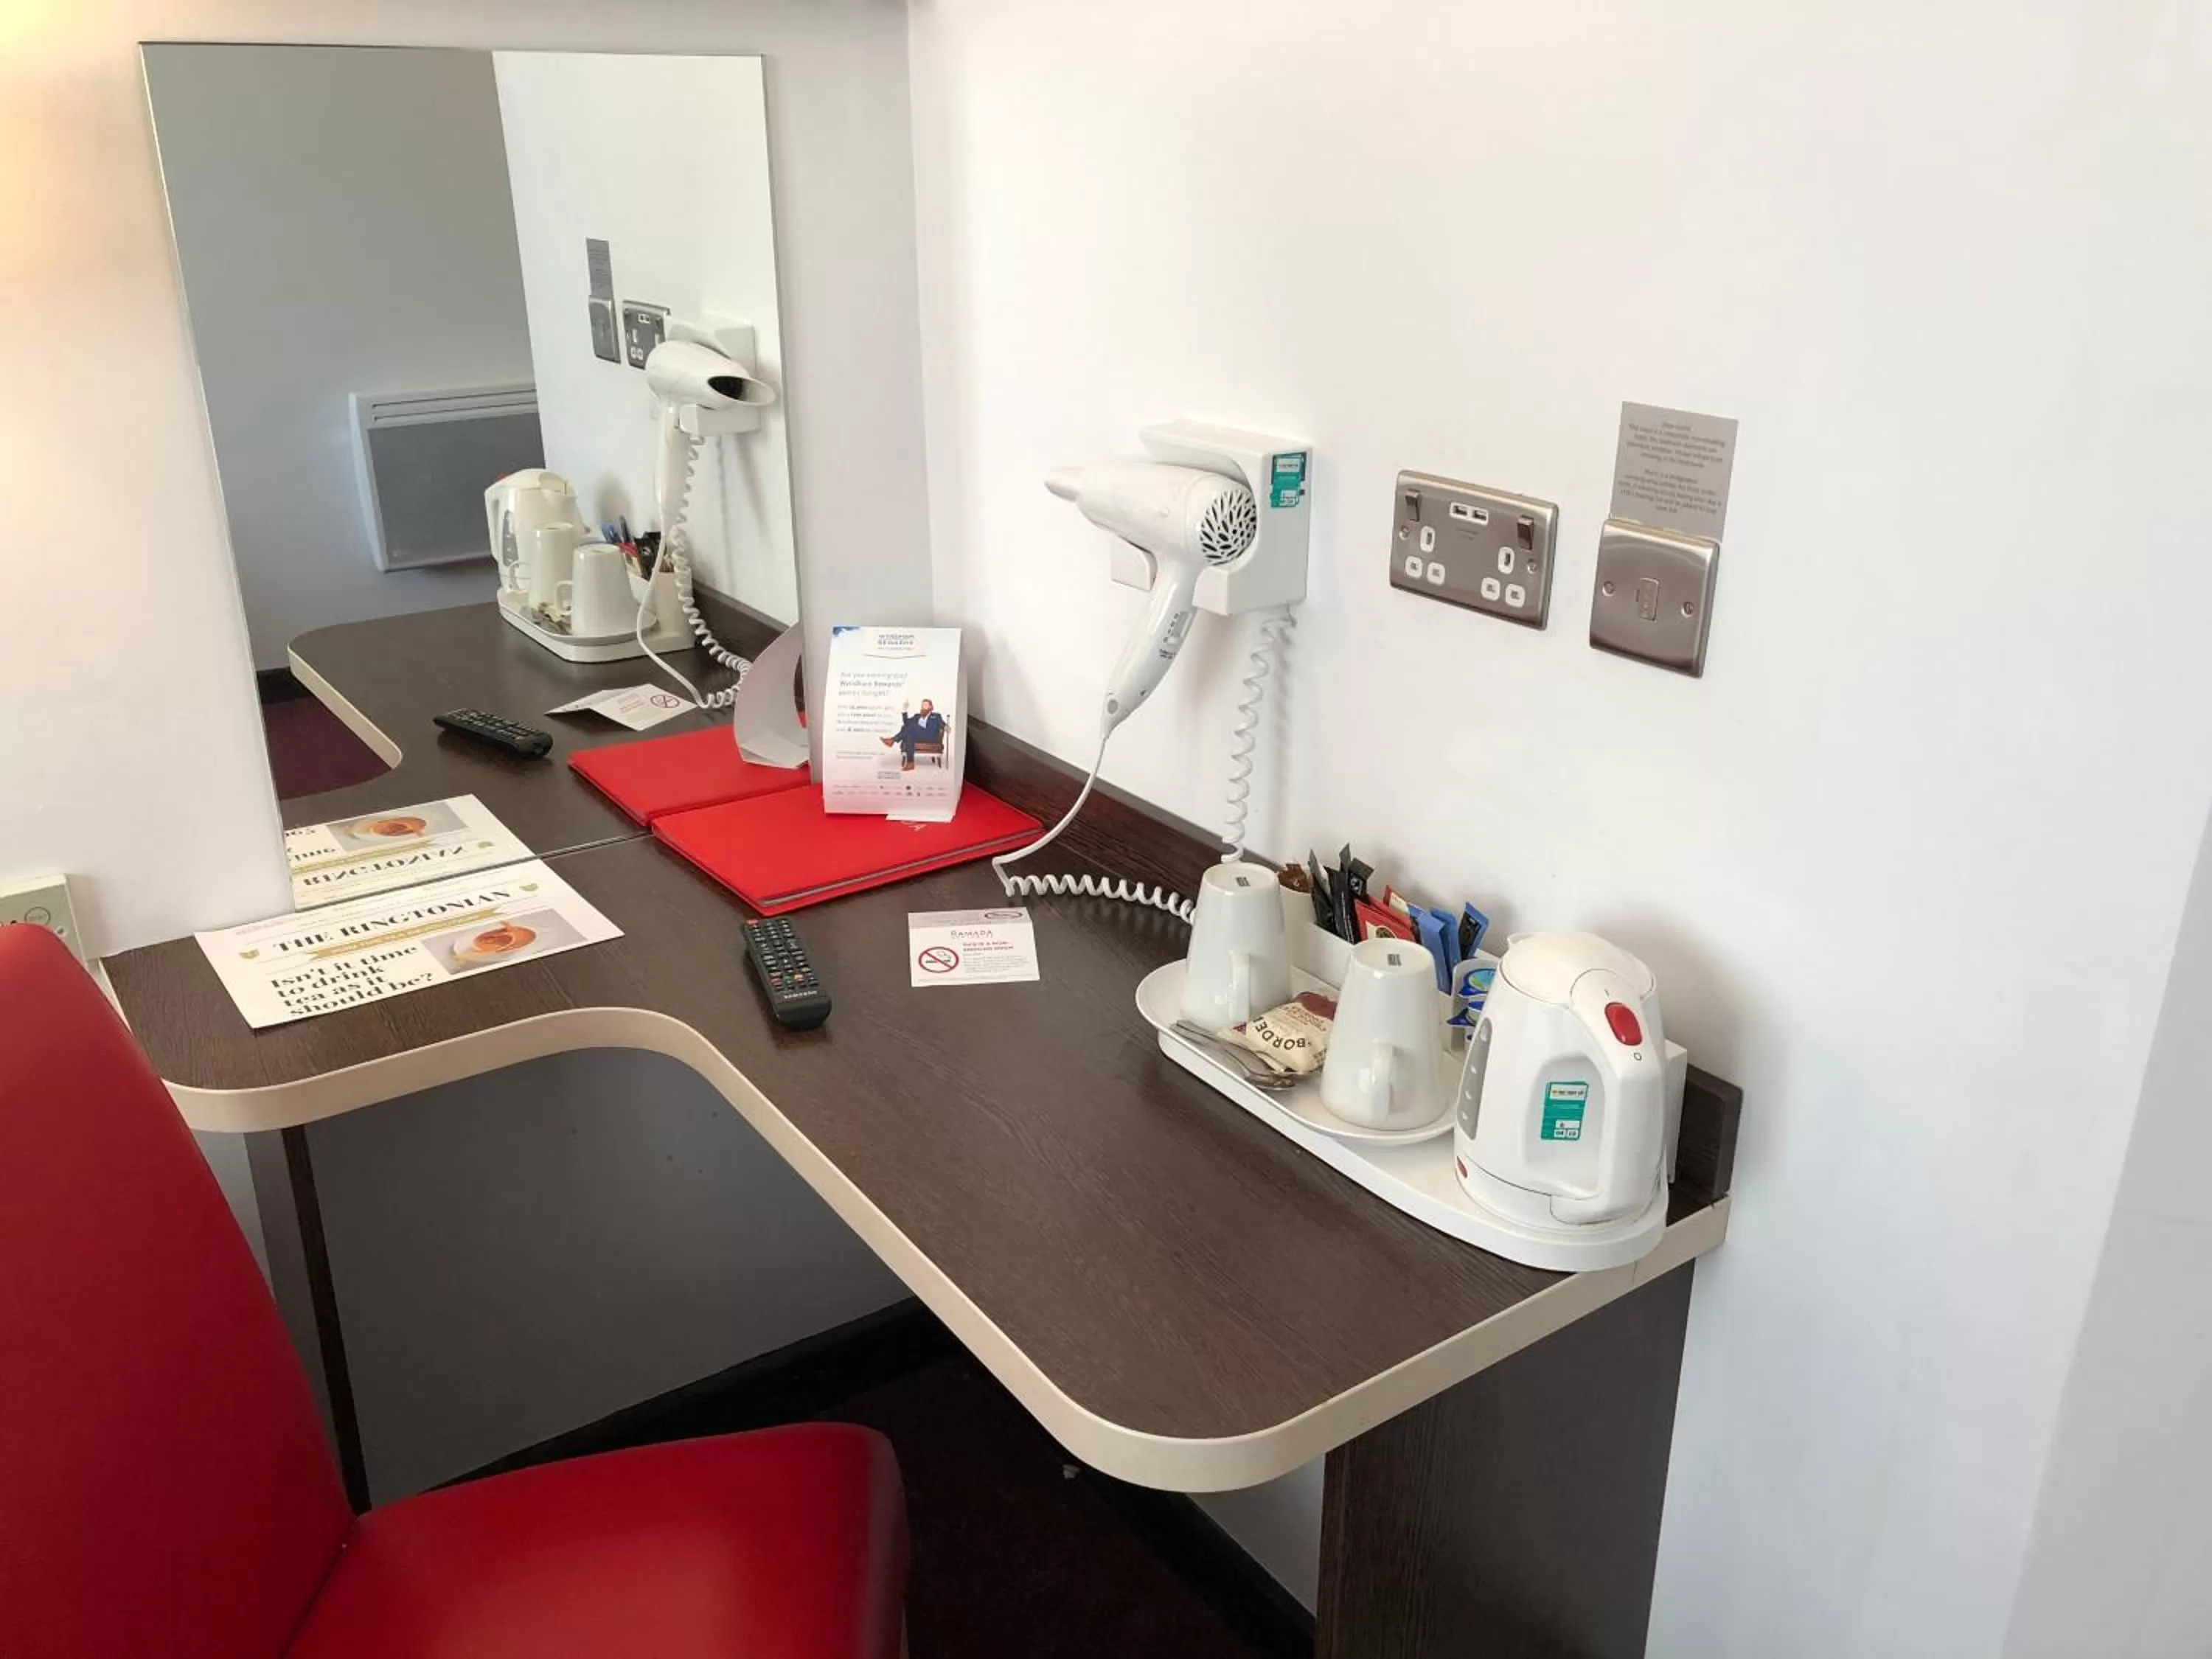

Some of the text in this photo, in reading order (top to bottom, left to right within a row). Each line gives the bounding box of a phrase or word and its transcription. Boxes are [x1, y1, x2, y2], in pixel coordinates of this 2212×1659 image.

[271, 933, 333, 952] THE
[340, 890, 511, 937] RINGTONIAN
[950, 930, 992, 939] RAMADA
[271, 947, 417, 988] Isn't it time
[278, 965, 385, 997] to drink
[284, 976, 388, 1006] tea as it
[290, 973, 433, 1015] should be?
[1253, 1017, 1306, 1051] BORDE
